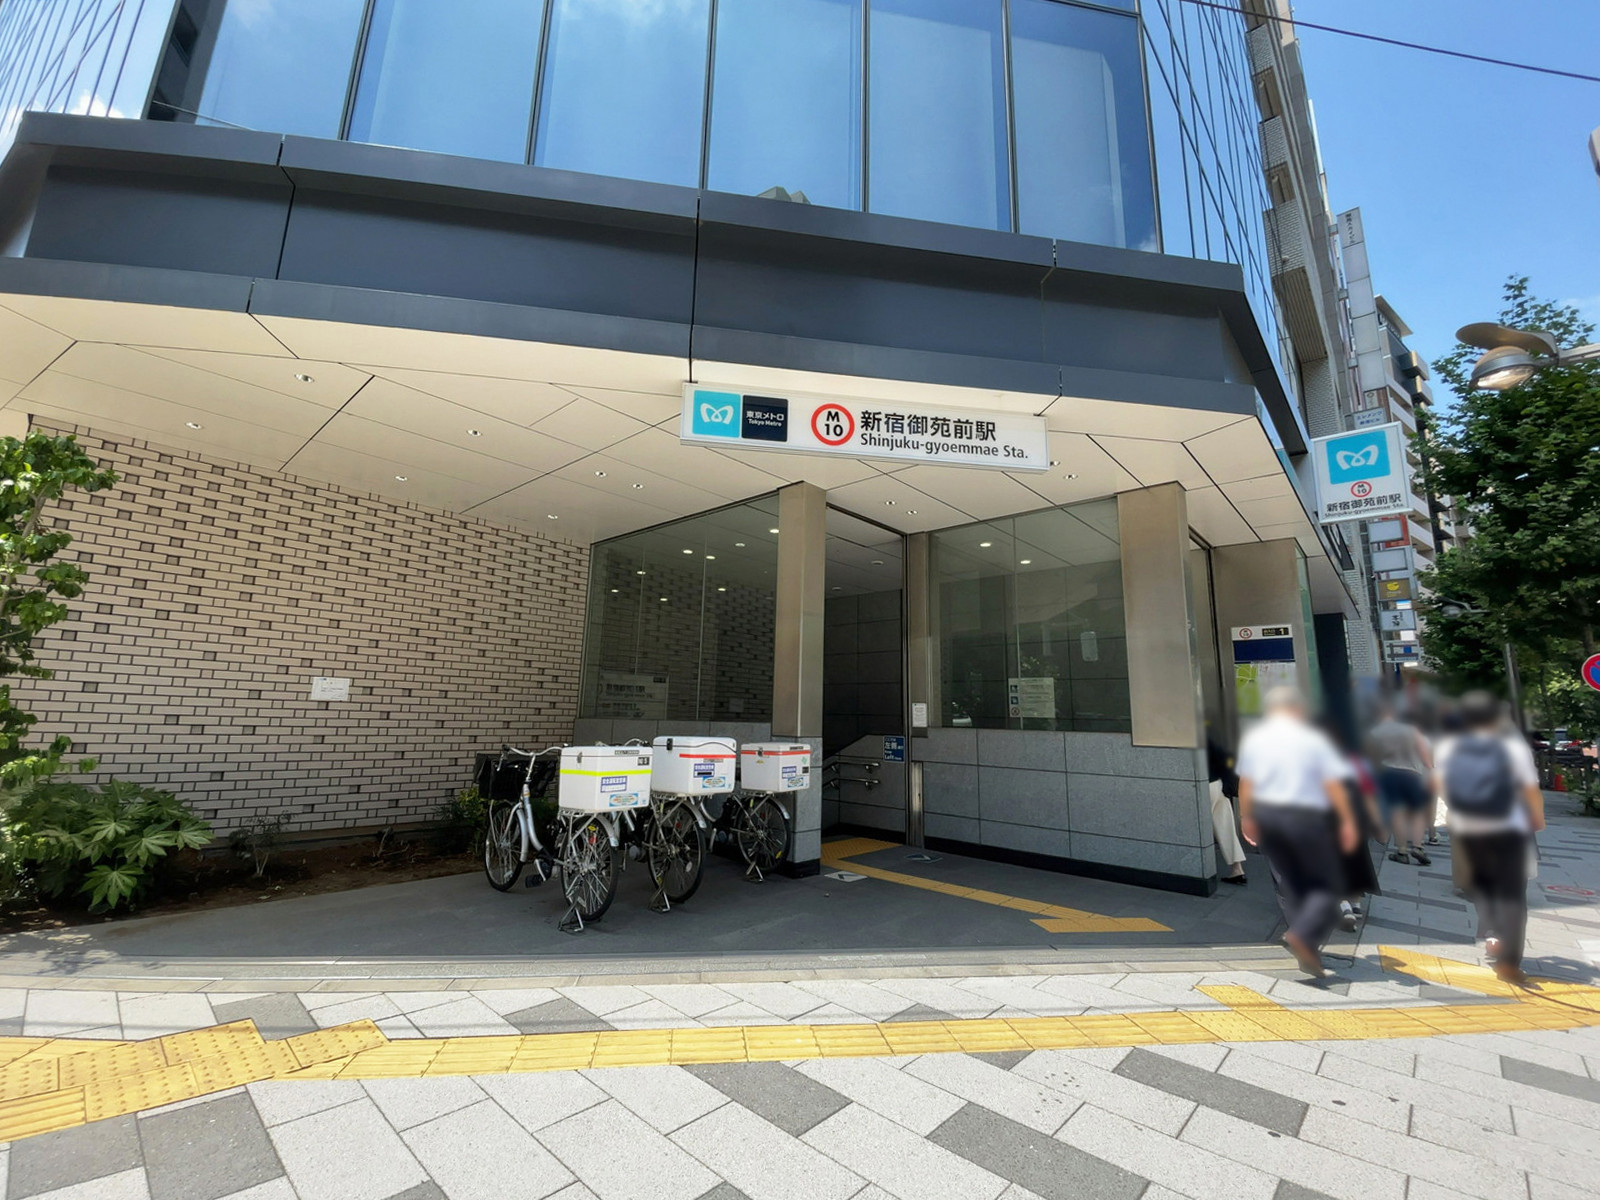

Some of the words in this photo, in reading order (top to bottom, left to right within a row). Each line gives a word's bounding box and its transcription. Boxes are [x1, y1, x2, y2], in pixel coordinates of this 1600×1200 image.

[746, 411, 784, 420] 東京メトロ
[826, 411, 840, 422] M
[824, 424, 843, 437] 10
[860, 410, 997, 441] 新宿御苑前駅
[860, 433, 999, 456] Shinjuku-gyoemmae
[1003, 445, 1029, 459] Sta.
[1327, 493, 1401, 512] 新宿御苑前駅
